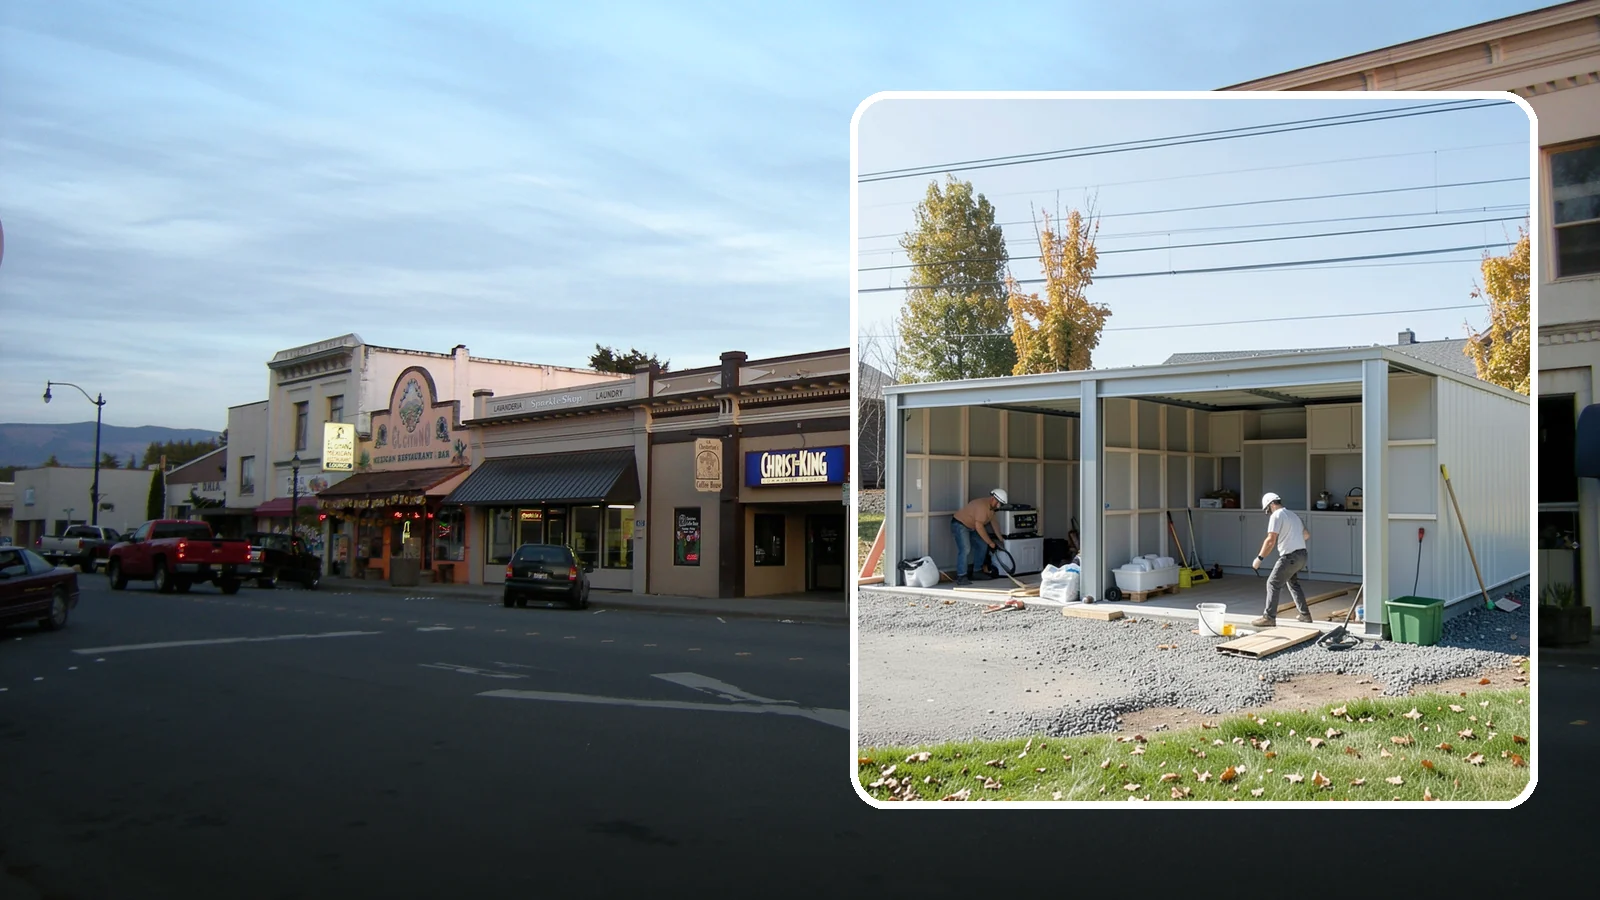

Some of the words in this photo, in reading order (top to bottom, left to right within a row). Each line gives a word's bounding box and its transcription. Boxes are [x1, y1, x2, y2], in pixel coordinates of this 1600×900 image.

[595, 389, 624, 400] LAUNDRY
[493, 402, 523, 412] LAVANDERIA
[530, 397, 560, 408] Sparkle
[562, 395, 582, 405] Shop
[374, 455, 396, 464] MEXICAN
[397, 451, 434, 462] RESTAURANT
[438, 450, 450, 459] BAR
[760, 452, 796, 478] CHRIST
[799, 450, 827, 476] KING
